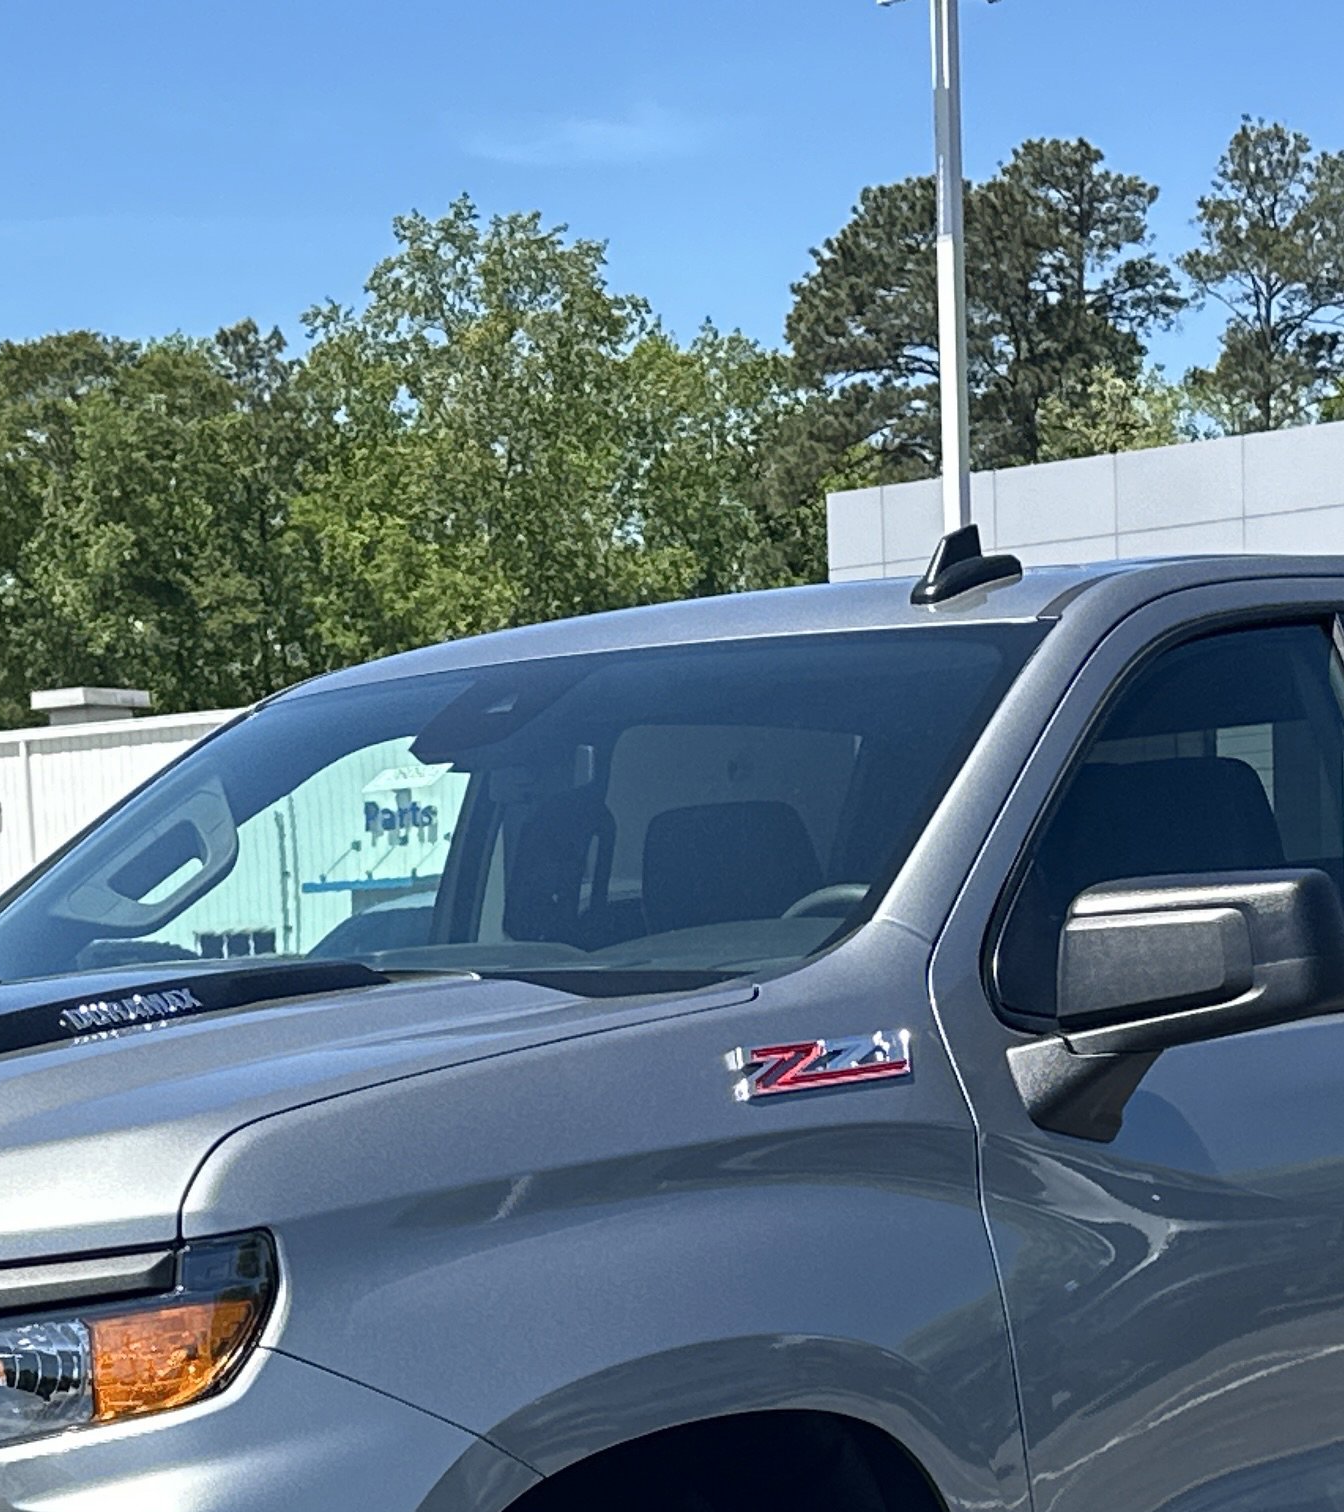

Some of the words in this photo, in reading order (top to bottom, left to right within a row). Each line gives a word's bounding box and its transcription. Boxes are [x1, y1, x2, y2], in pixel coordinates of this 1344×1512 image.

[364, 800, 438, 832] Parts
[60, 987, 203, 1031] DURAMAX
[726, 1029, 910, 1101] Z71
